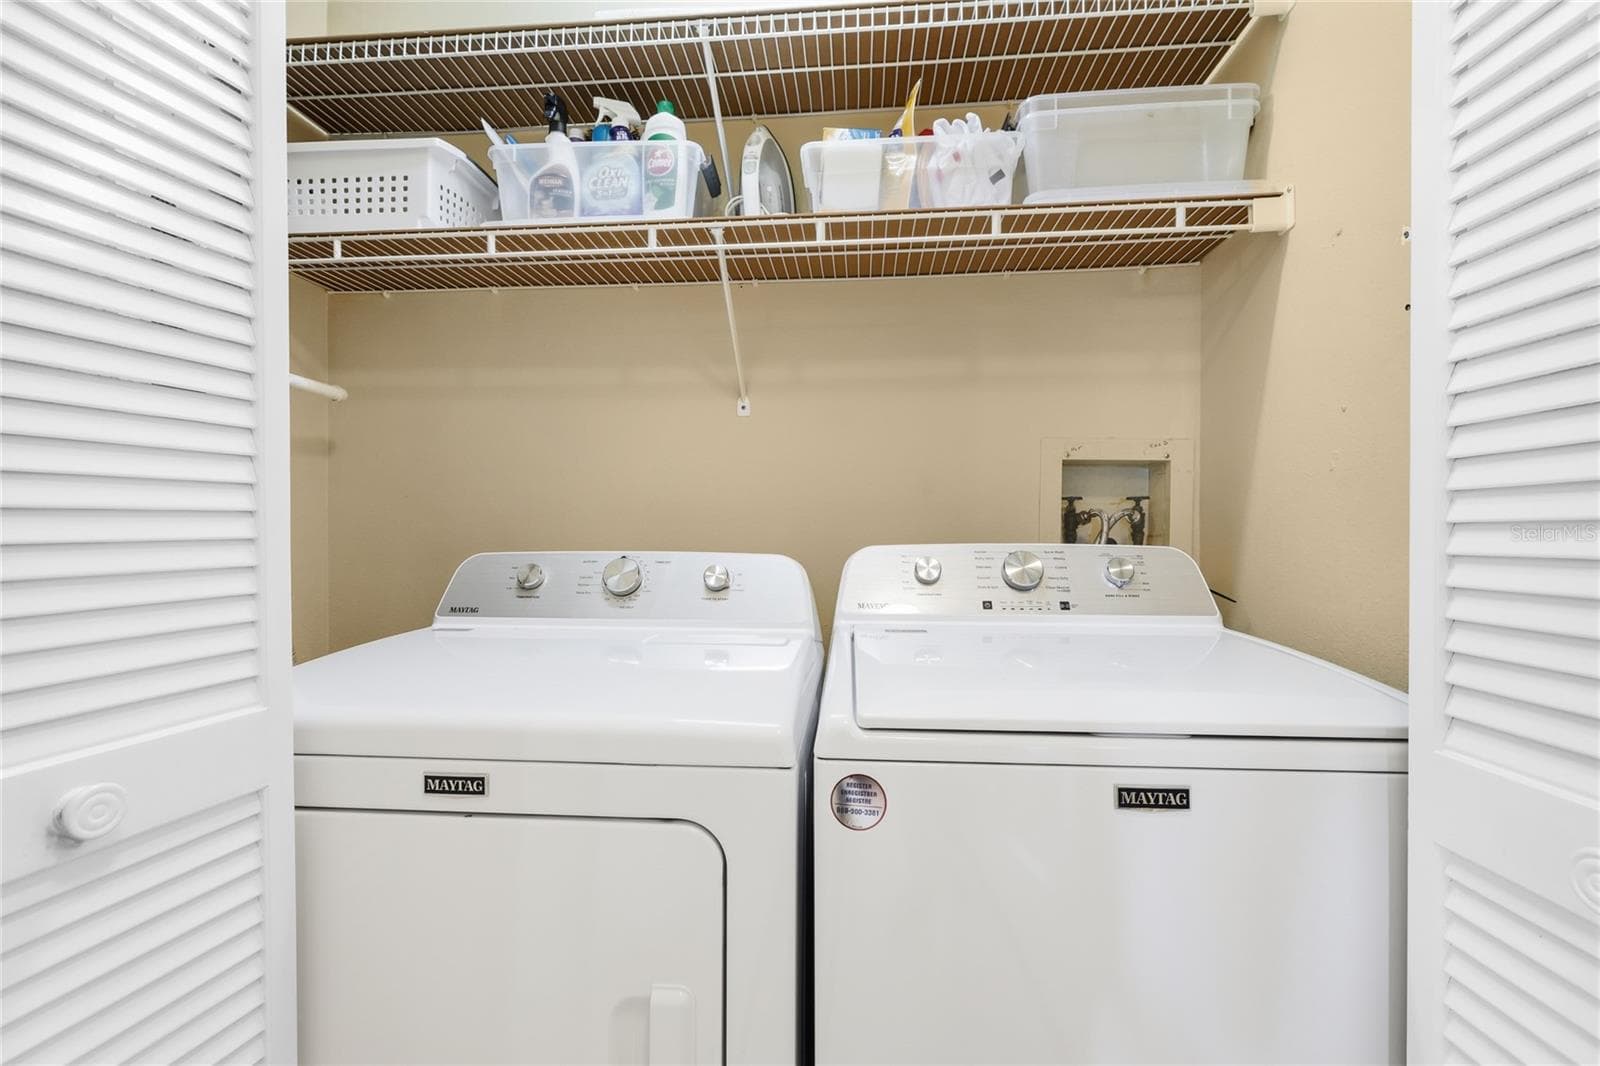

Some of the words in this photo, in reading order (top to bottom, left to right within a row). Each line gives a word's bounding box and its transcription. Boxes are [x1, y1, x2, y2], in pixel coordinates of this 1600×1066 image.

[599, 166, 623, 179] OXI
[589, 176, 628, 189] CLEAN
[449, 606, 479, 614] MAYTAG
[426, 778, 484, 792] MAYTAG
[1120, 791, 1188, 806] MAYTAG
